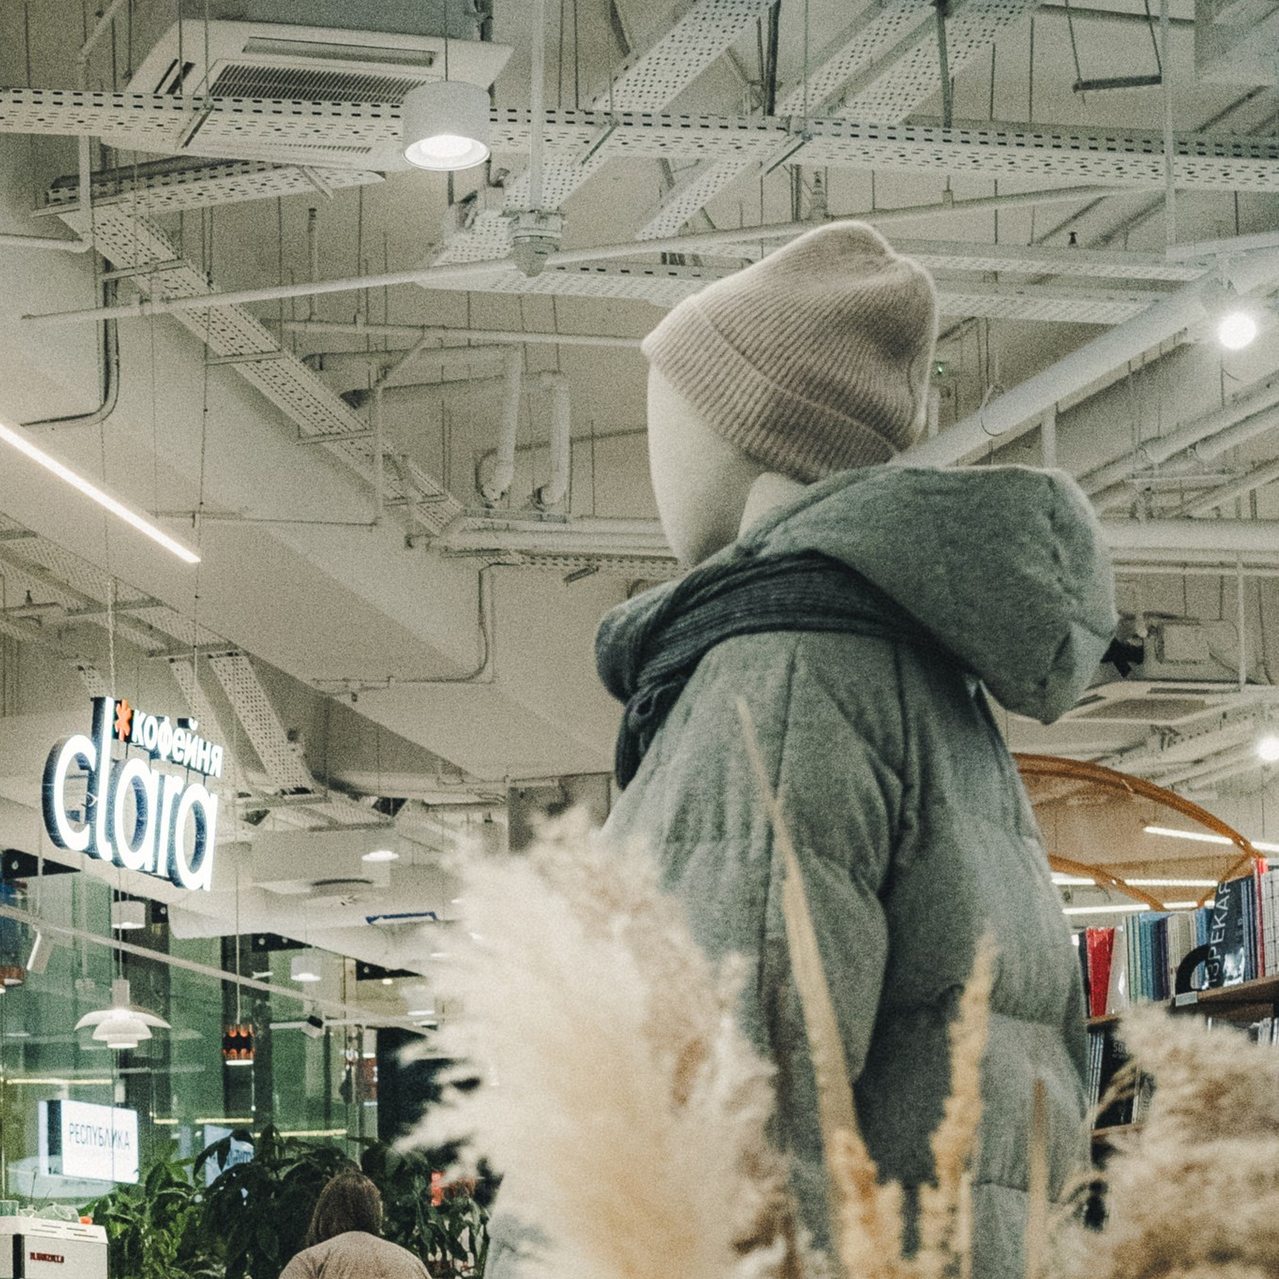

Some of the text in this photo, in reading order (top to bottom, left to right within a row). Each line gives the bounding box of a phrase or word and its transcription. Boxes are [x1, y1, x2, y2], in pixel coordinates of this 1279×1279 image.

[132, 709, 224, 778] кофейня
[44, 696, 219, 892] clara
[68, 1122, 131, 1151] РЕСПУБЛИКА
